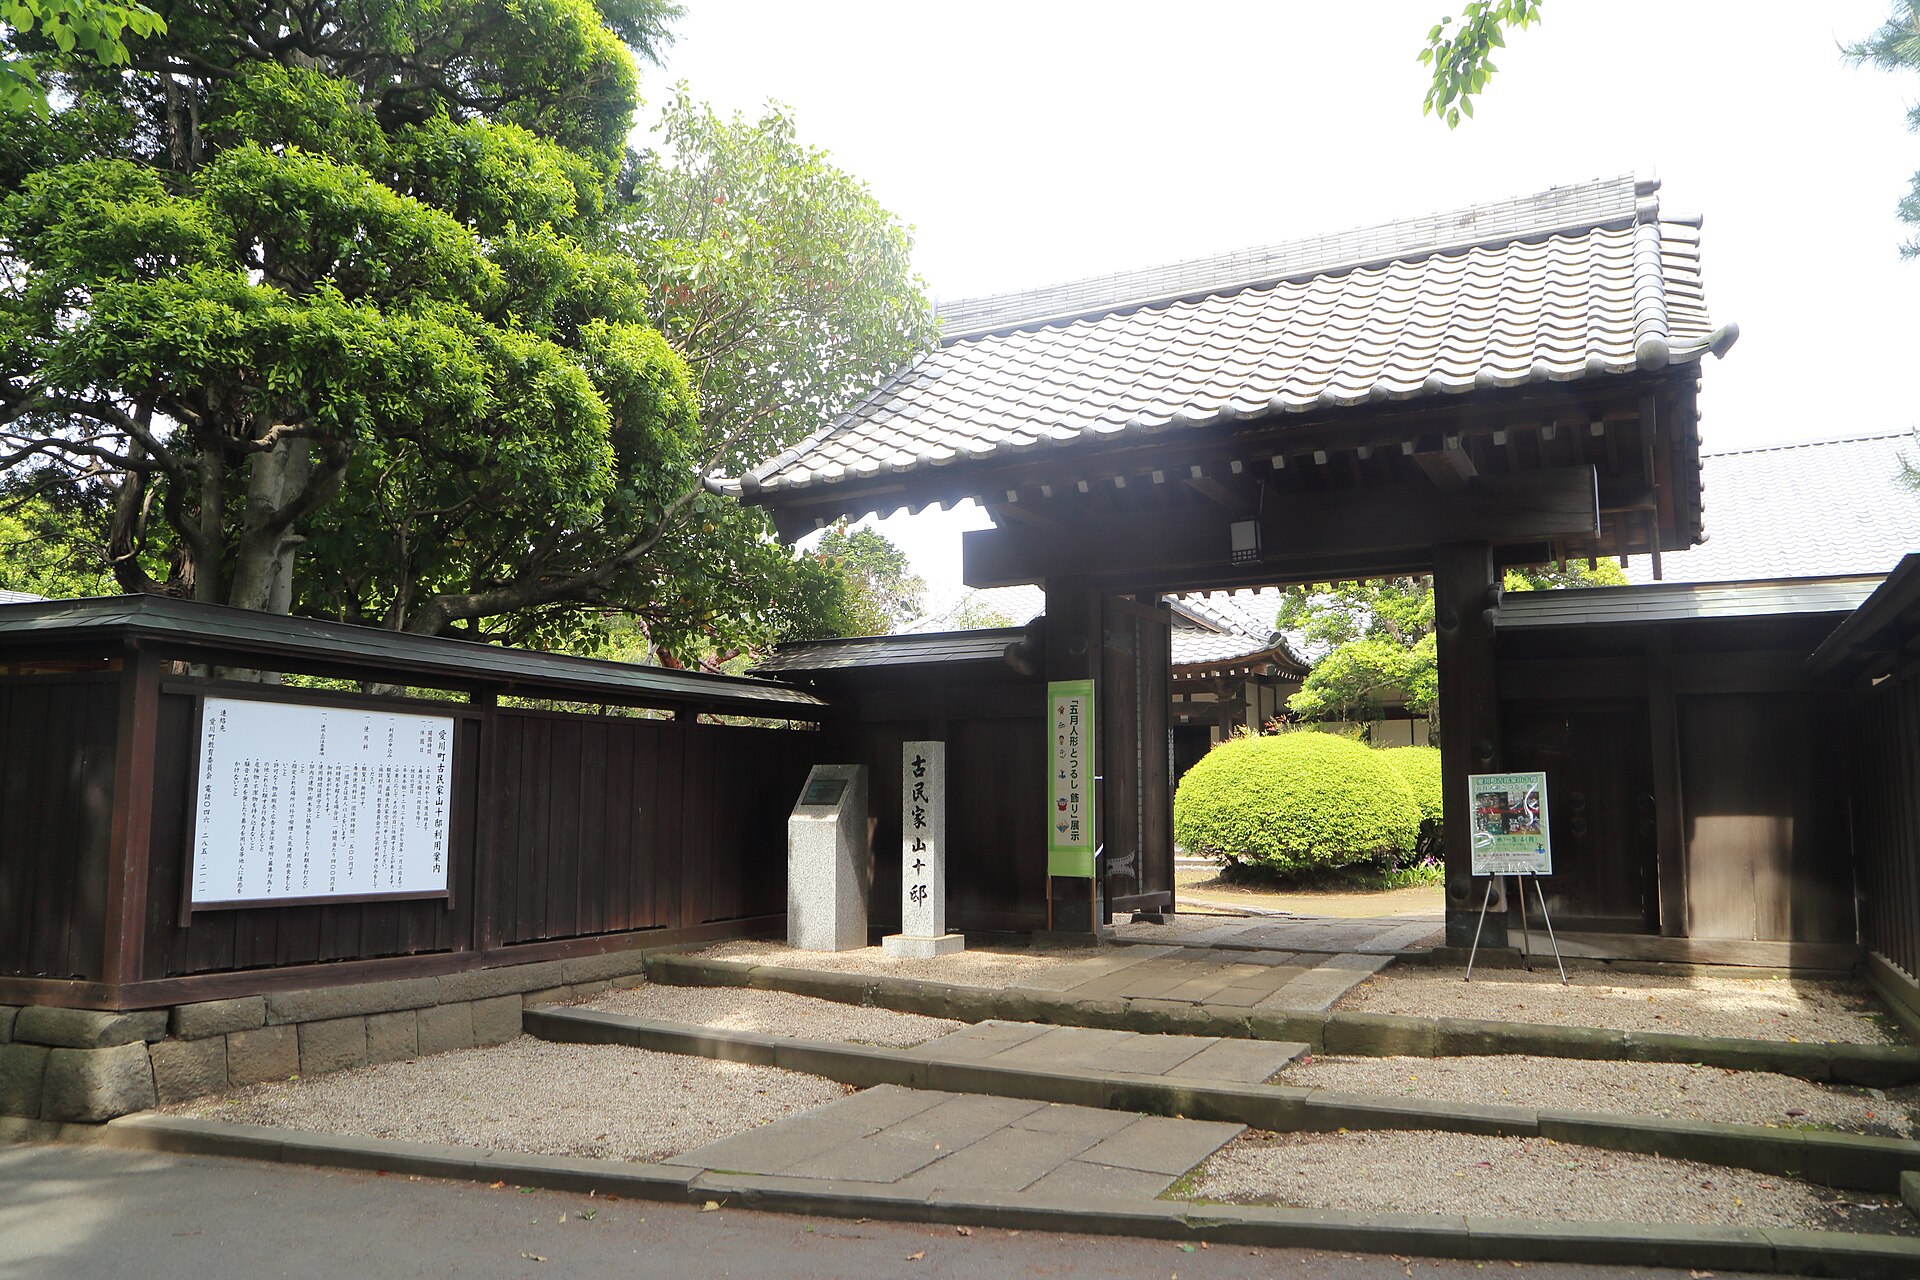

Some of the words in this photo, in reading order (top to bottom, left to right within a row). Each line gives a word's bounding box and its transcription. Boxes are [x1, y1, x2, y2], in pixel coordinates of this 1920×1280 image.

[219, 709, 228, 733] 連絡先
[1069, 700, 1080, 841] 「五月人形とつるし飾り」展示
[432, 729, 447, 874] 愛川町古民家山十邸利用案内
[909, 754, 929, 908] 古民家山十邸
